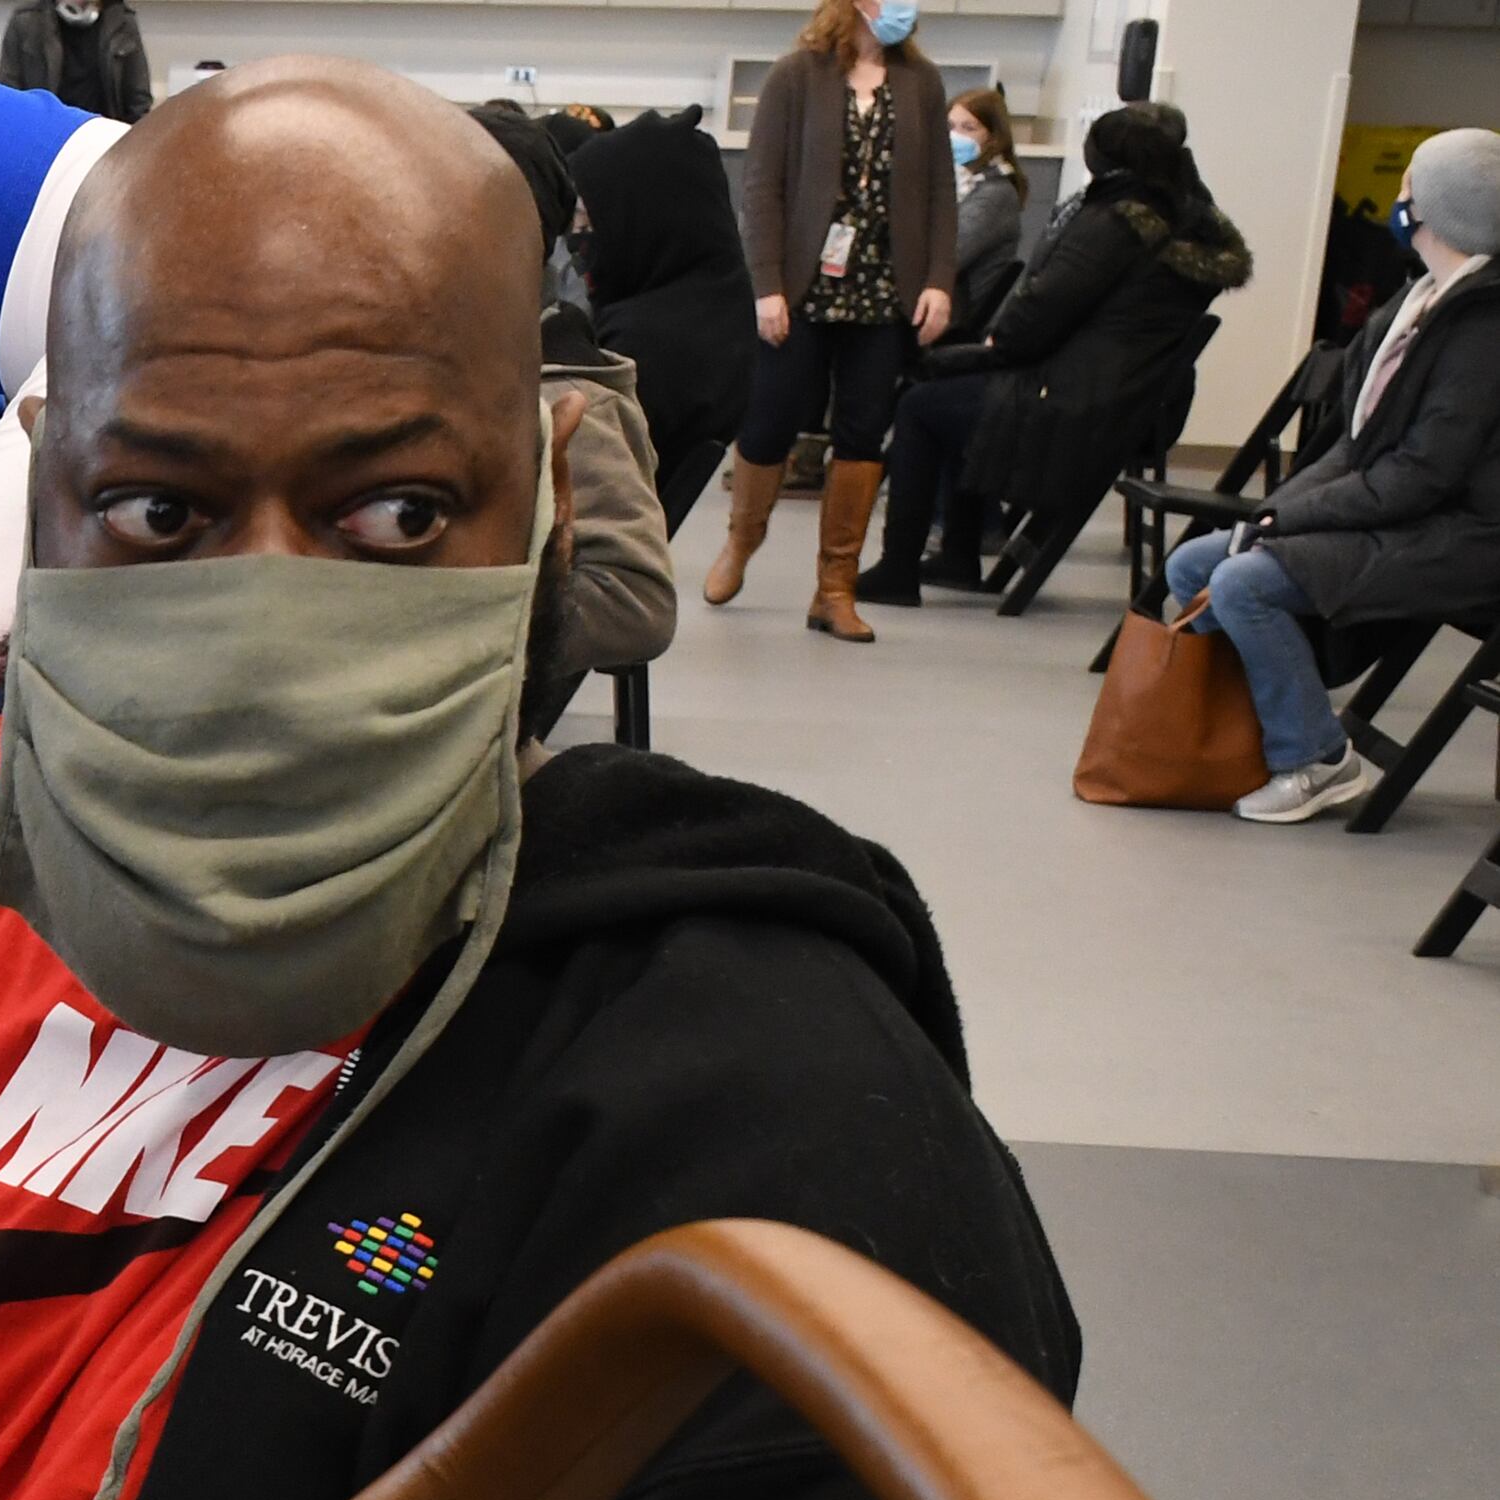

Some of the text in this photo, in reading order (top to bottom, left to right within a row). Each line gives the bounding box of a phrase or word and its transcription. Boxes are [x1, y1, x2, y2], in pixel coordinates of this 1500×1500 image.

[236, 1268, 401, 1378] TREVIS
[241, 1325, 267, 1346] AT
[264, 1336, 345, 1388] HORACE
